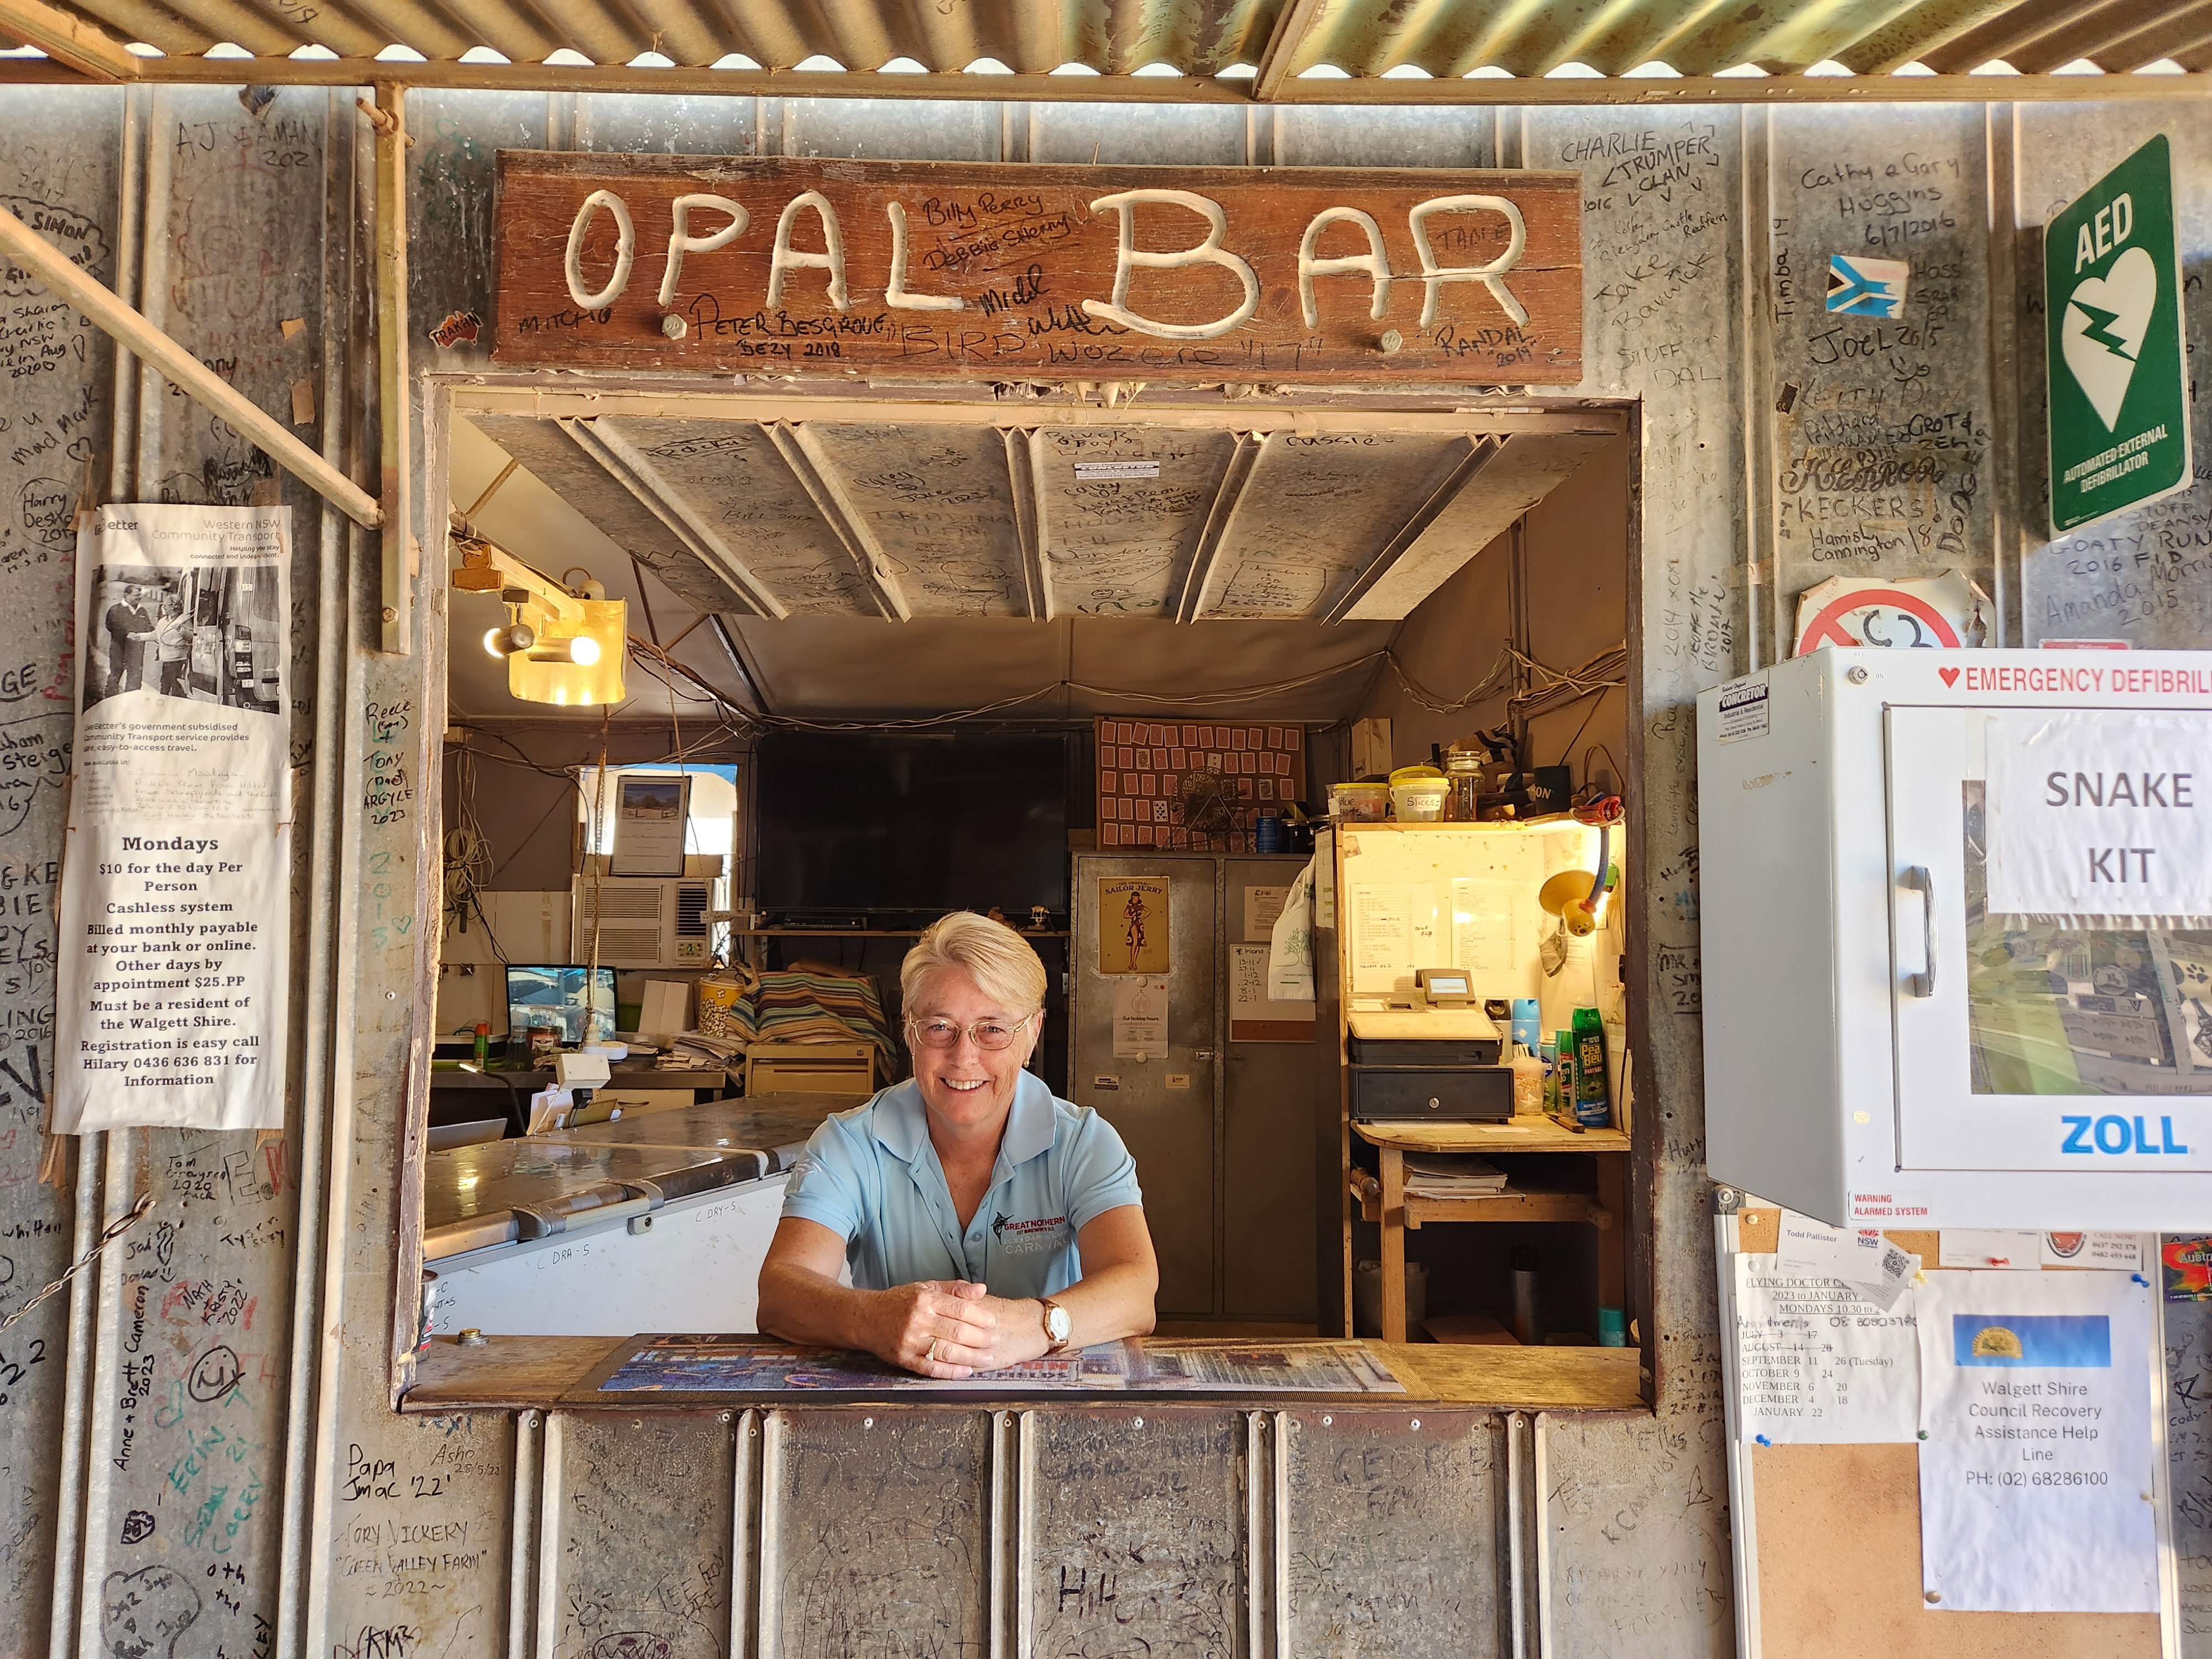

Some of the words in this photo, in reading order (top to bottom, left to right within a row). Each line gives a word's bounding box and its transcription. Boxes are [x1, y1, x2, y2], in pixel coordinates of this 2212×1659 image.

[1562, 131, 1655, 163] CHARLIE
[1639, 163, 1690, 191] CLAN
[1801, 163, 1874, 189] Cathy
[2074, 192, 2133, 275] AED
[565, 189, 966, 310] OPAL
[1081, 187, 1533, 341] BAR
[1773, 248, 1796, 324] Timba
[2063, 447, 2117, 484] AUTOMATED
[2117, 424, 2168, 458] EXTERNAL
[2080, 450, 2149, 493] DEFIBRILLATOR
[203, 519, 253, 530] Western
[255, 519, 280, 529] NSW
[152, 530, 225, 542] Community
[227, 531, 280, 541] Transport
[1966, 666, 2104, 692] EMERGENCY
[2111, 668, 2212, 694] DEFIBRIL
[1721, 684, 1766, 708] CONCRETOR
[129, 723, 186, 731] government
[127, 733, 174, 741] Transport
[210, 733, 249, 742] provides
[97, 744, 165, 752] easy-to-access
[2044, 771, 2195, 808] SNAKE
[122, 836, 219, 853] Mondays
[99, 863, 122, 875] $10
[127, 863, 150, 874] for
[155, 863, 181, 873] the
[186, 862, 213, 875] day
[218, 862, 243, 873] Per
[2088, 847, 2157, 884] KIT
[144, 881, 197, 892] Person
[1105, 885, 1134, 895] SAILOR
[1136, 885, 1163, 894] JERRY
[106, 902, 175, 914] Cashless
[180, 902, 233, 914] system
[87, 924, 123, 935] Billed
[129, 923, 194, 936] monthly
[199, 921, 258, 935] payable
[86, 944, 98, 953] at
[101, 944, 137, 956] your
[142, 942, 181, 952] bank
[185, 942, 202, 951] or
[206, 940, 257, 951] online.
[116, 960, 161, 972] Other
[165, 959, 200, 972] days
[205, 959, 222, 972] by
[93, 978, 190, 993] appointment
[195, 976, 245, 988] $25.PP
[90, 1000, 128, 1011] Must
[133, 999, 150, 1010] be
[168, 998, 229, 1010] resident
[234, 997, 251, 1008] of
[101, 1019, 124, 1030] the
[129, 1017, 189, 1031] Walgett
[193, 1016, 236, 1027] Shire.
[81, 1040, 172, 1053] Registration
[176, 1038, 188, 1048] is
[192, 1038, 227, 1050] easy
[232, 1036, 259, 1047] call
[1580, 1043, 1600, 1056] Pea
[83, 1058, 128, 1071] Hilary
[134, 1057, 169, 1068] 0436
[173, 1056, 199, 1067] 636
[204, 1055, 229, 1066] 831
[234, 1054, 257, 1065] for
[124, 1075, 214, 1086] Information
[2060, 1114, 2188, 1155] ZOLL
[1854, 1193, 1892, 1204] WARNING
[1854, 1206, 1893, 1217] ALARMED
[1895, 1207, 1928, 1217] SYSTEM
[1004, 1221, 1030, 1230] GREAT
[1787, 1229, 1804, 1238] Todd
[1806, 1232, 1838, 1243] Pallister
[1858, 1237, 1879, 1246] NSW
[1746, 1277, 1783, 1287] FLYING
[1786, 1278, 1832, 1287] DOCTOR
[1772, 1291, 1795, 1300] 2023
[1808, 1291, 1858, 1301] JANUARY
[1779, 1304, 1834, 1313] MONDAYS
[1837, 1305, 1861, 1313] 10.30
[1863, 1305, 1872, 1313] to
[122, 1285, 148, 1354] Cameron
[1742, 1343, 1781, 1352] AUGUST
[1742, 1356, 1801, 1365] SEPTEMBER
[1808, 1357, 1818, 1365] 11
[1835, 1357, 1846, 1365] 26
[1849, 1357, 1893, 1367] (Tuesday)
[1742, 1369, 1790, 1378] OCTOBER
[1793, 1370, 1800, 1378] 9
[1822, 1370, 1833, 1378] 24
[1743, 1383, 1801, 1391] NOVEMBER
[1808, 1383, 1814, 1391] 6
[1836, 1383, 1848, 1392] 20
[1982, 1382, 2044, 1397] Walgett
[2048, 1382, 2088, 1396] Shire
[1743, 1395, 1799, 1404] DECEMBER
[1808, 1396, 1814, 1404] 4
[1838, 1396, 1848, 1405] 18
[1753, 1408, 1803, 1417] JANUARY
[1812, 1408, 1823, 1417] 22
[1969, 1404, 2028, 1418] Council
[2032, 1404, 2102, 1421] Recovery
[1974, 1426, 2058, 1439] Assistance
[2062, 1426, 2099, 1442] Help
[2022, 1448, 2054, 1462] Line
[1965, 1471, 1994, 1485] PH:
[1997, 1470, 2028, 1488] (02)
[2032, 1471, 2109, 1486] 68286100
